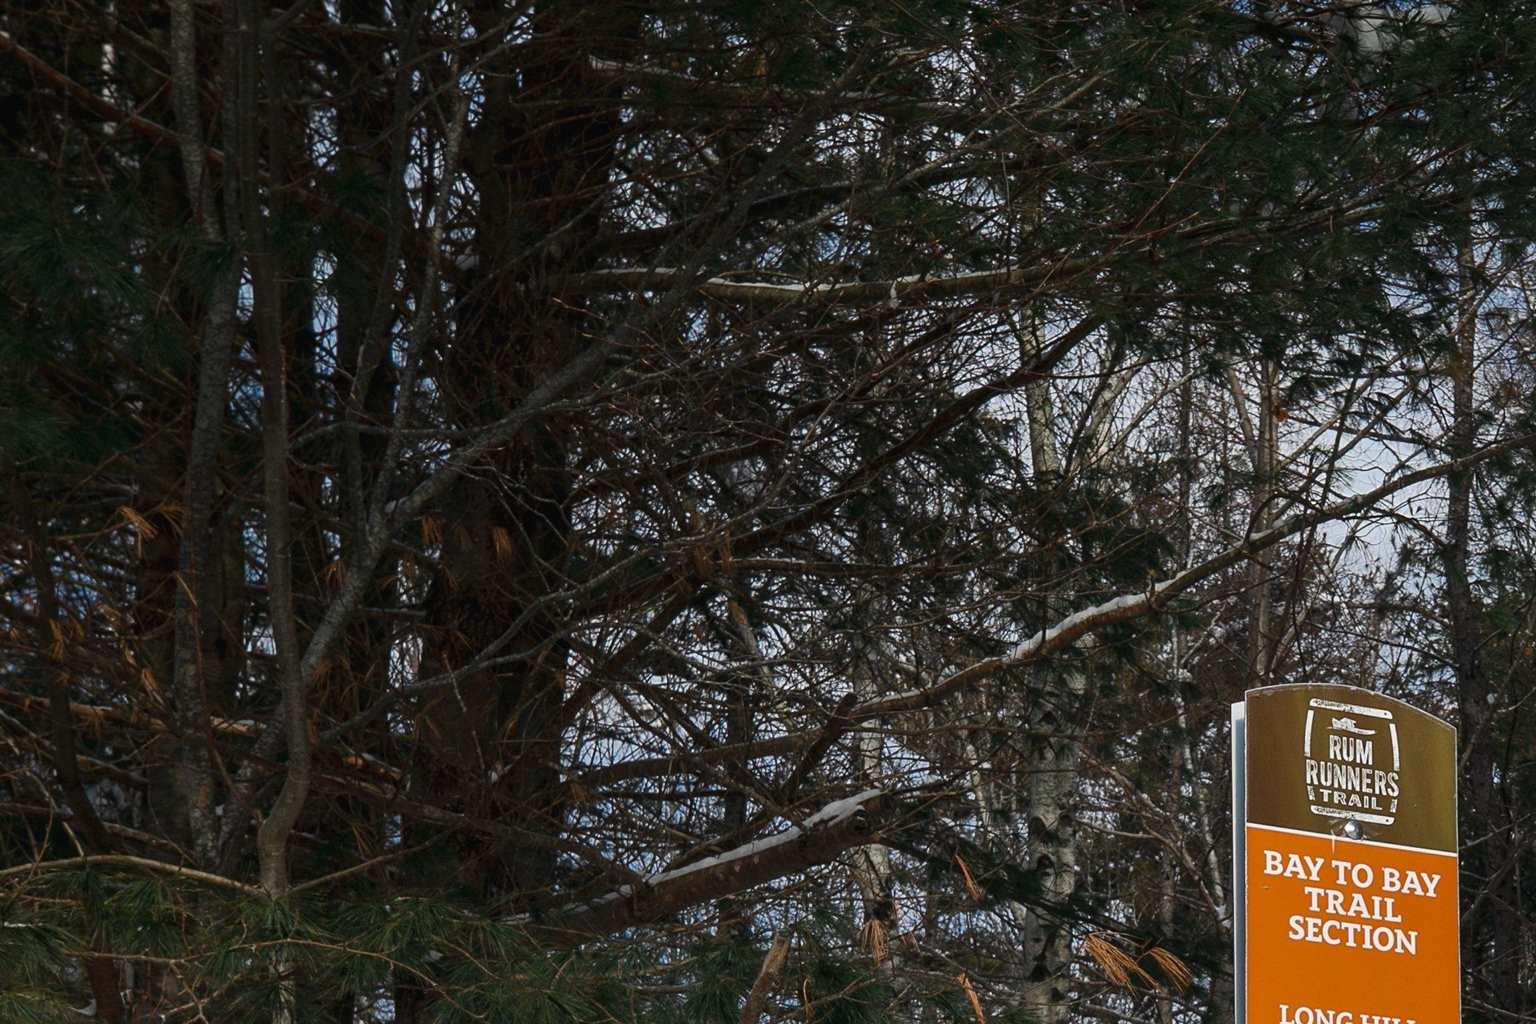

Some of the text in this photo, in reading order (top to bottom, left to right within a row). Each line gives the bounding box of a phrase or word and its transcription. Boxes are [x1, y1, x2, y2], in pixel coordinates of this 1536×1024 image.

[1329, 734, 1373, 765] RUM
[1306, 759, 1400, 796] RUNNERS
[1319, 788, 1383, 811] TRAIL
[1263, 850, 1441, 898] BAY TO BAY
[1304, 886, 1402, 923] TRAIL
[1288, 915, 1418, 955] SECTION
